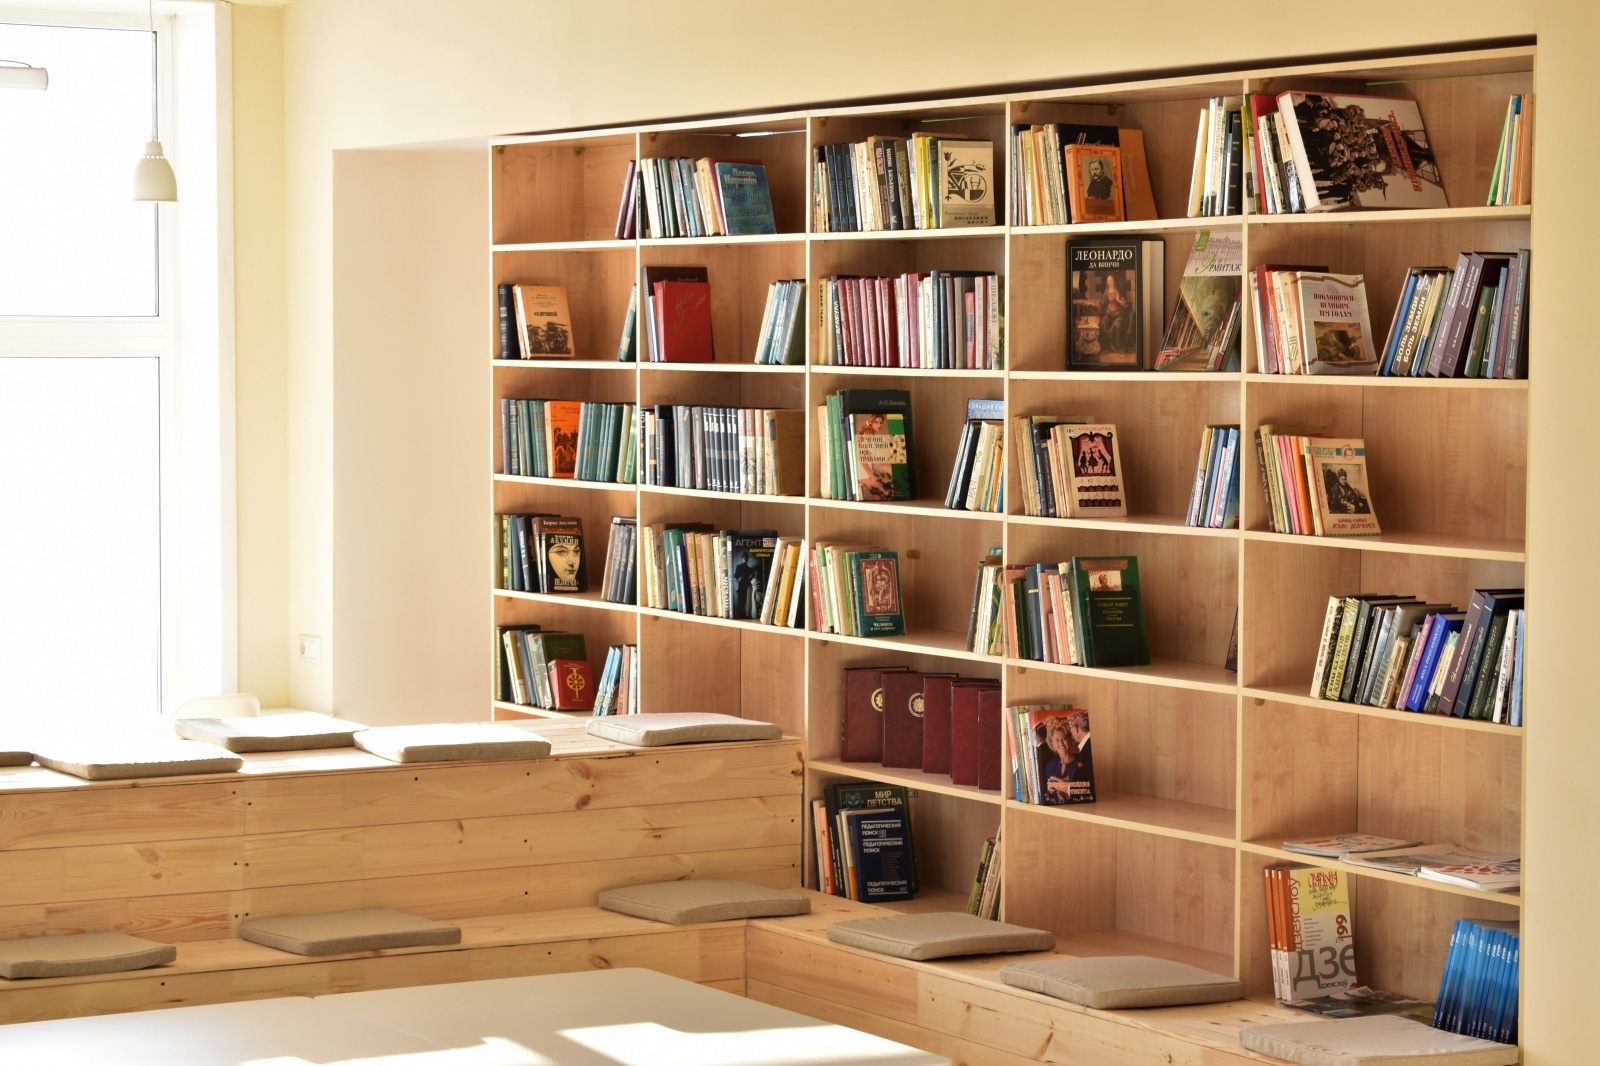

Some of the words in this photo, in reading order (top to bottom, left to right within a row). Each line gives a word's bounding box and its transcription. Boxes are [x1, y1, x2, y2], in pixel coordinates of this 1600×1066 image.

[1075, 250, 1133, 262] ЛЕОНАРДО
[1098, 261, 1120, 269] ВИНЧИ
[1396, 334, 1408, 363] БОЛЬ
[1405, 296, 1419, 333] ЗЕМЛИ
[1403, 334, 1415, 363] БОЛЬ
[1412, 296, 1426, 334] ЗЕМЛИ
[550, 537, 579, 545] АКУНИН
[735, 539, 762, 547] АГЕНТ
[875, 791, 892, 799] МИР
[867, 798, 902, 807] ДЕТСТВА
